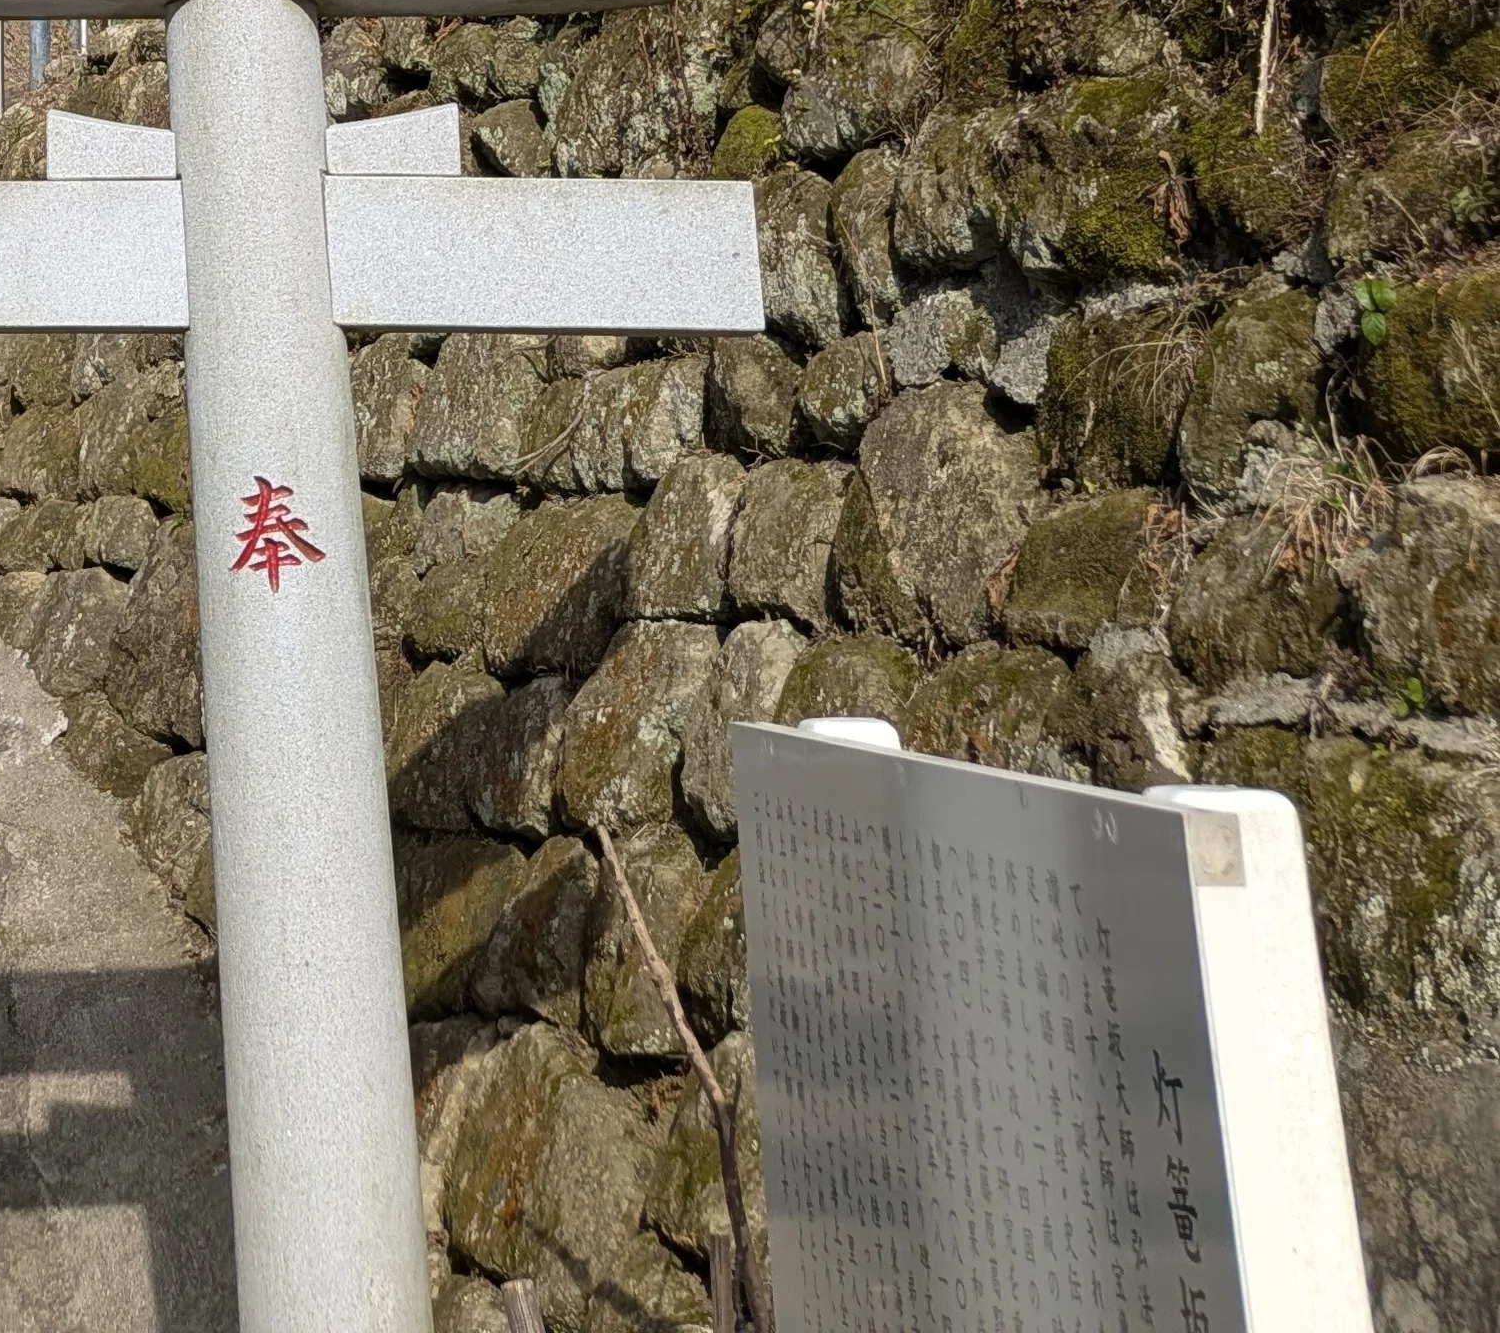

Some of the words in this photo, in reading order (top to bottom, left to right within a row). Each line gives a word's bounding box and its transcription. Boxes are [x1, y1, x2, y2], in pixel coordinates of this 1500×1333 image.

[228, 475, 327, 594] 奉
[1043, 867, 1108, 1333] 讃岐の国に誕生され
